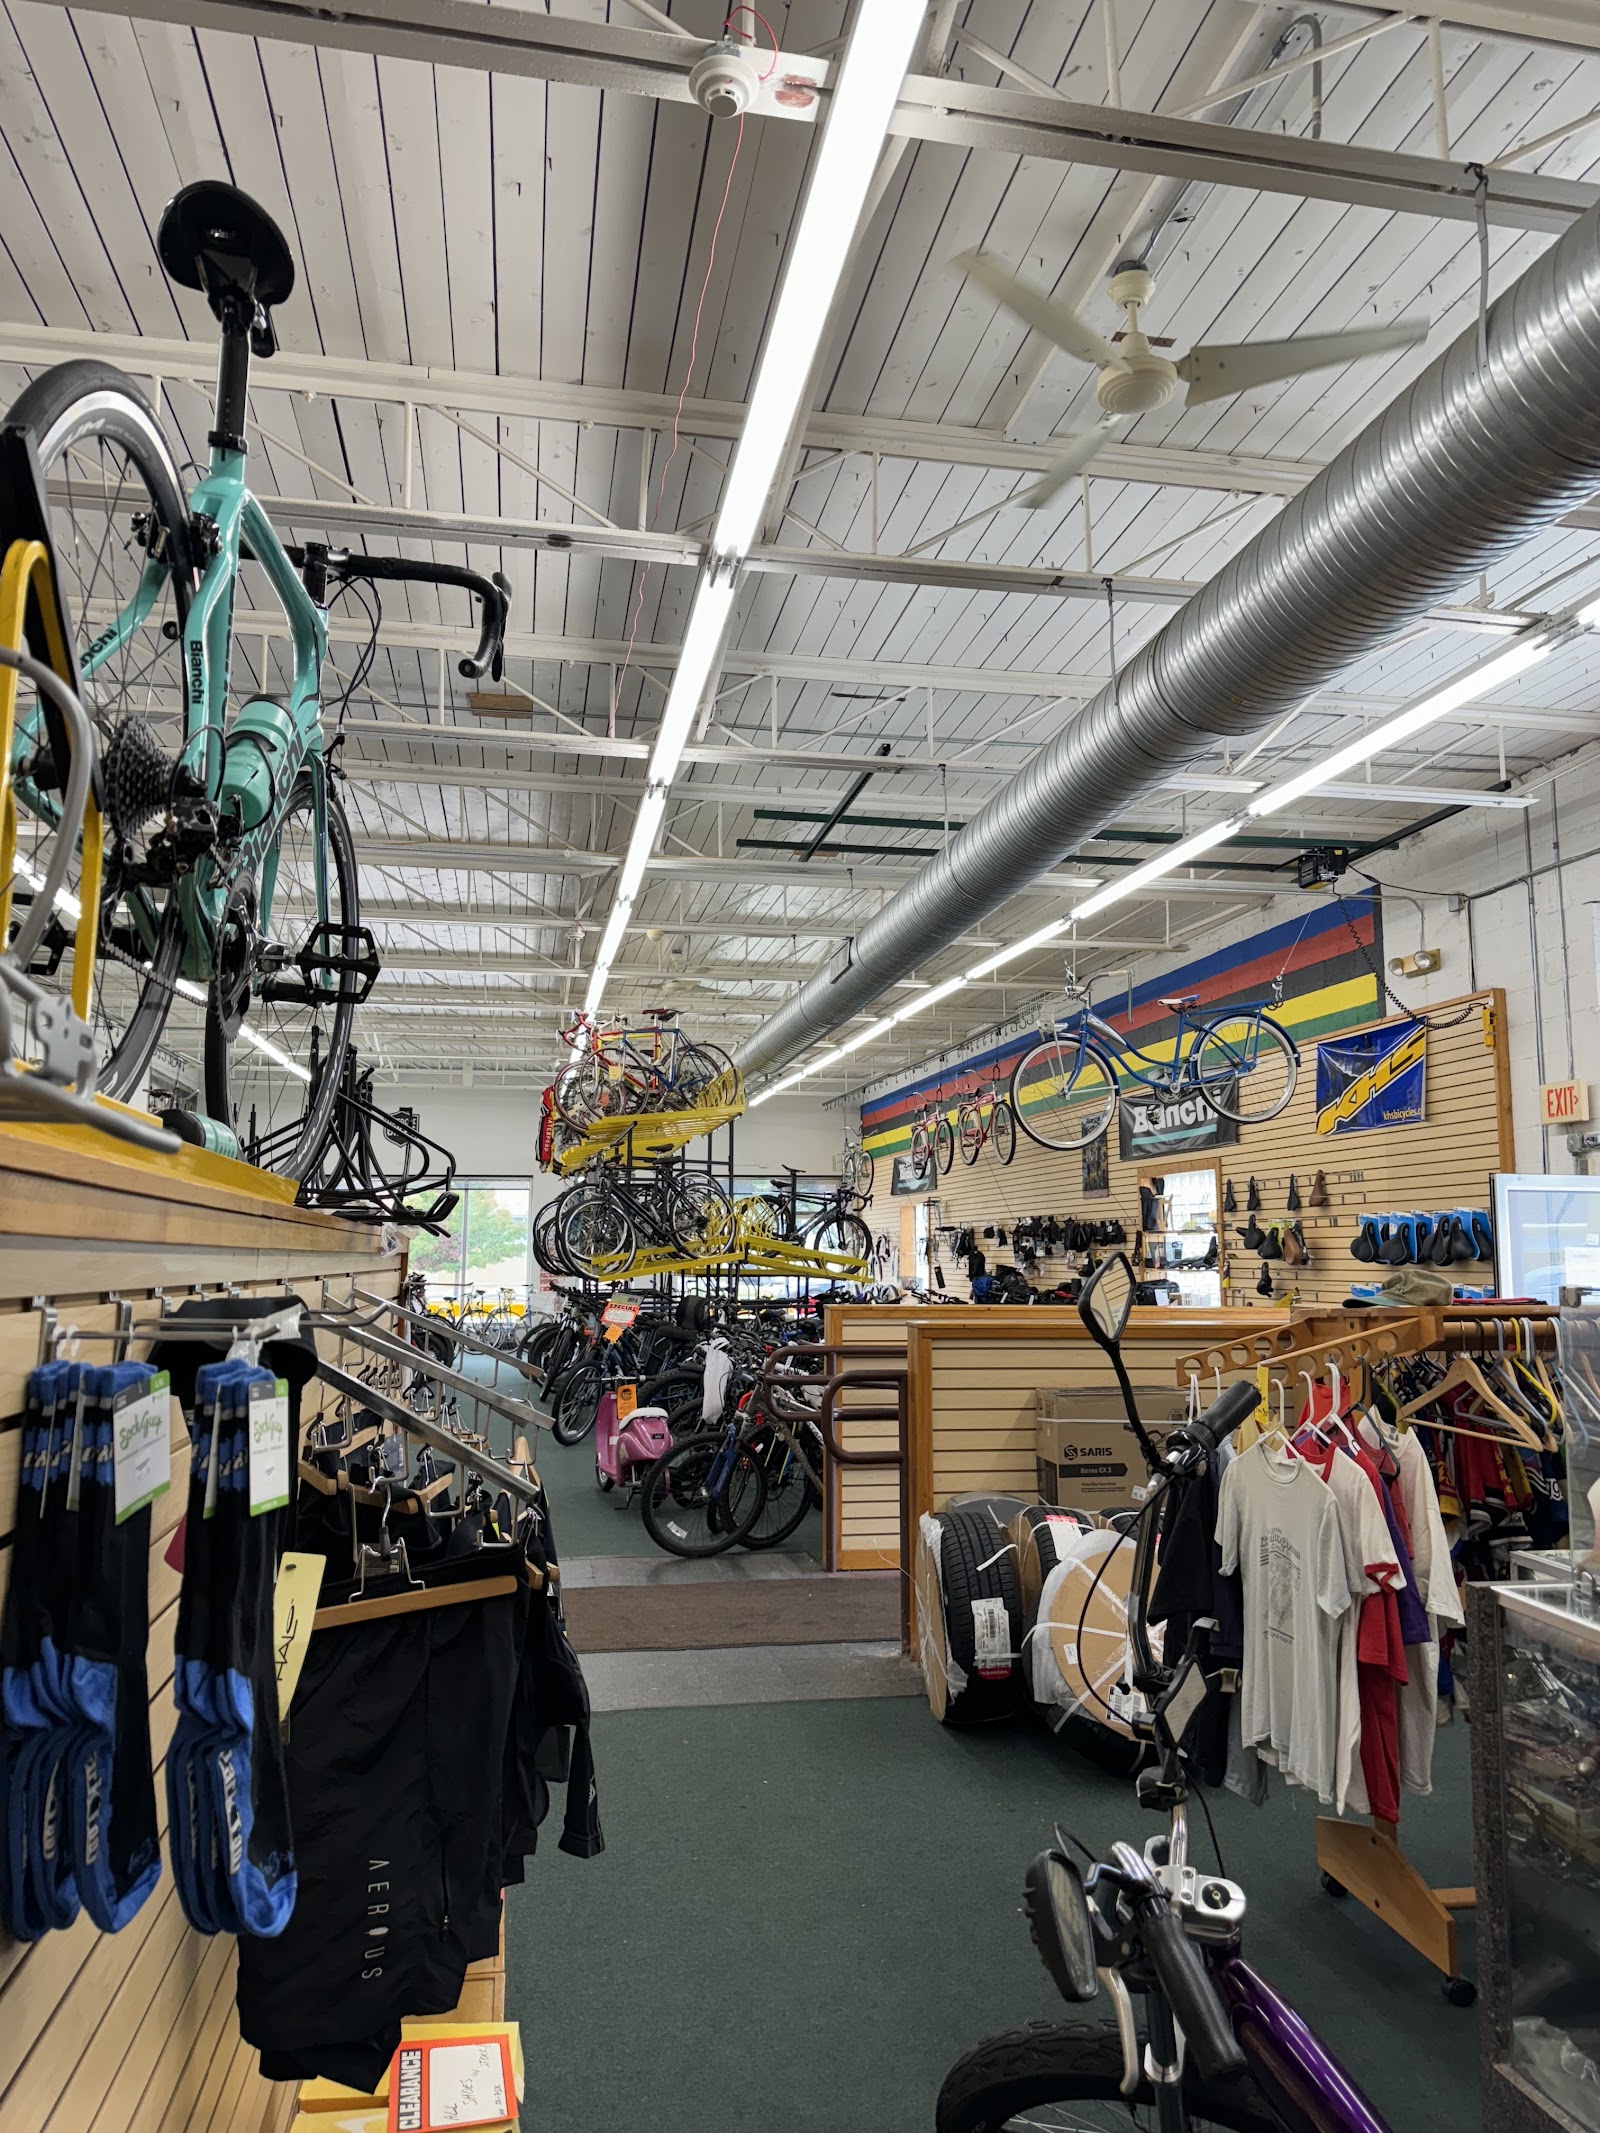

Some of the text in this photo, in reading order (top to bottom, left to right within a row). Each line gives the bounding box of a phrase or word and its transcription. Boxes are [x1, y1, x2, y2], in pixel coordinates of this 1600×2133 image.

[189, 640, 204, 705] Bianchi
[1316, 1022, 1425, 1135] KHS
[1547, 1086, 1574, 1118] EXIT
[608, 1303, 637, 1312] SPECIAL
[1080, 1447, 1113, 1457] SARIS
[398, 2050, 421, 2130] CLEARANCE
[459, 2077, 478, 2106] SHOES
